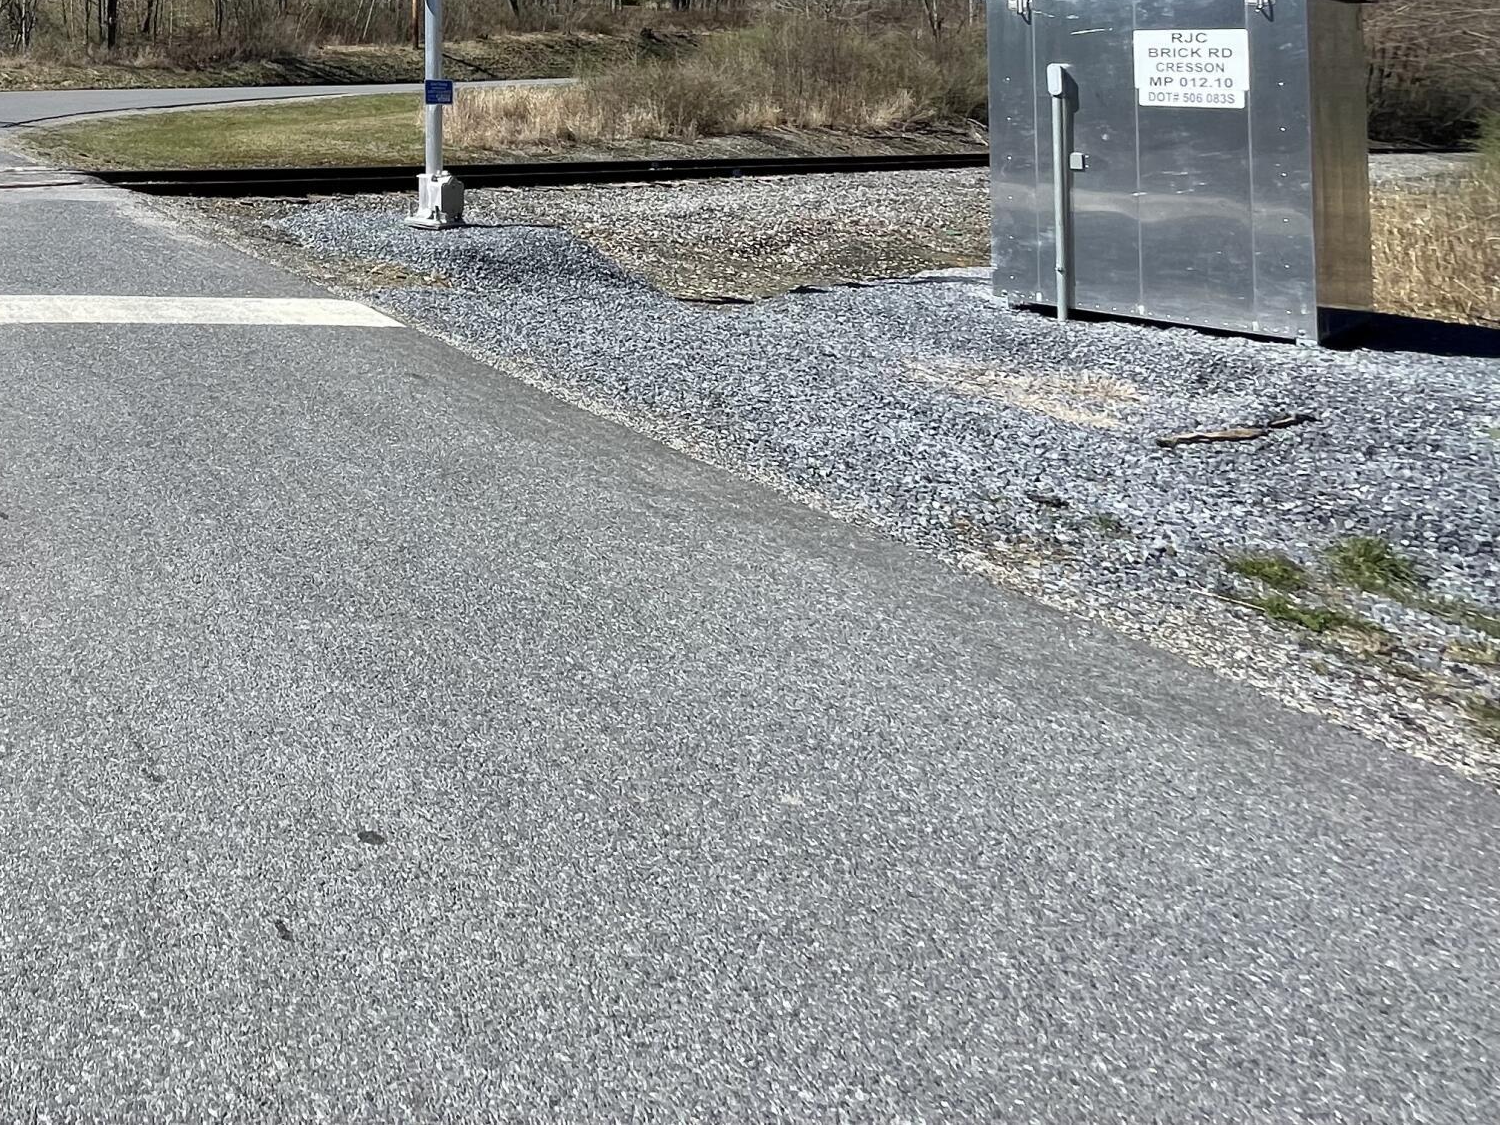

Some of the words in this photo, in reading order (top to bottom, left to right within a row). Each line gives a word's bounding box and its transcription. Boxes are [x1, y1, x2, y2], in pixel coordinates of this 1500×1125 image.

[1171, 32, 1208, 44] RJC
[1148, 48, 1202, 58] BRICK
[1208, 48, 1233, 58] RD
[1155, 62, 1225, 73] CRESSON
[1149, 77, 1174, 87] MP
[1179, 77, 1234, 88] 012.10
[1148, 91, 1179, 102] DOT#
